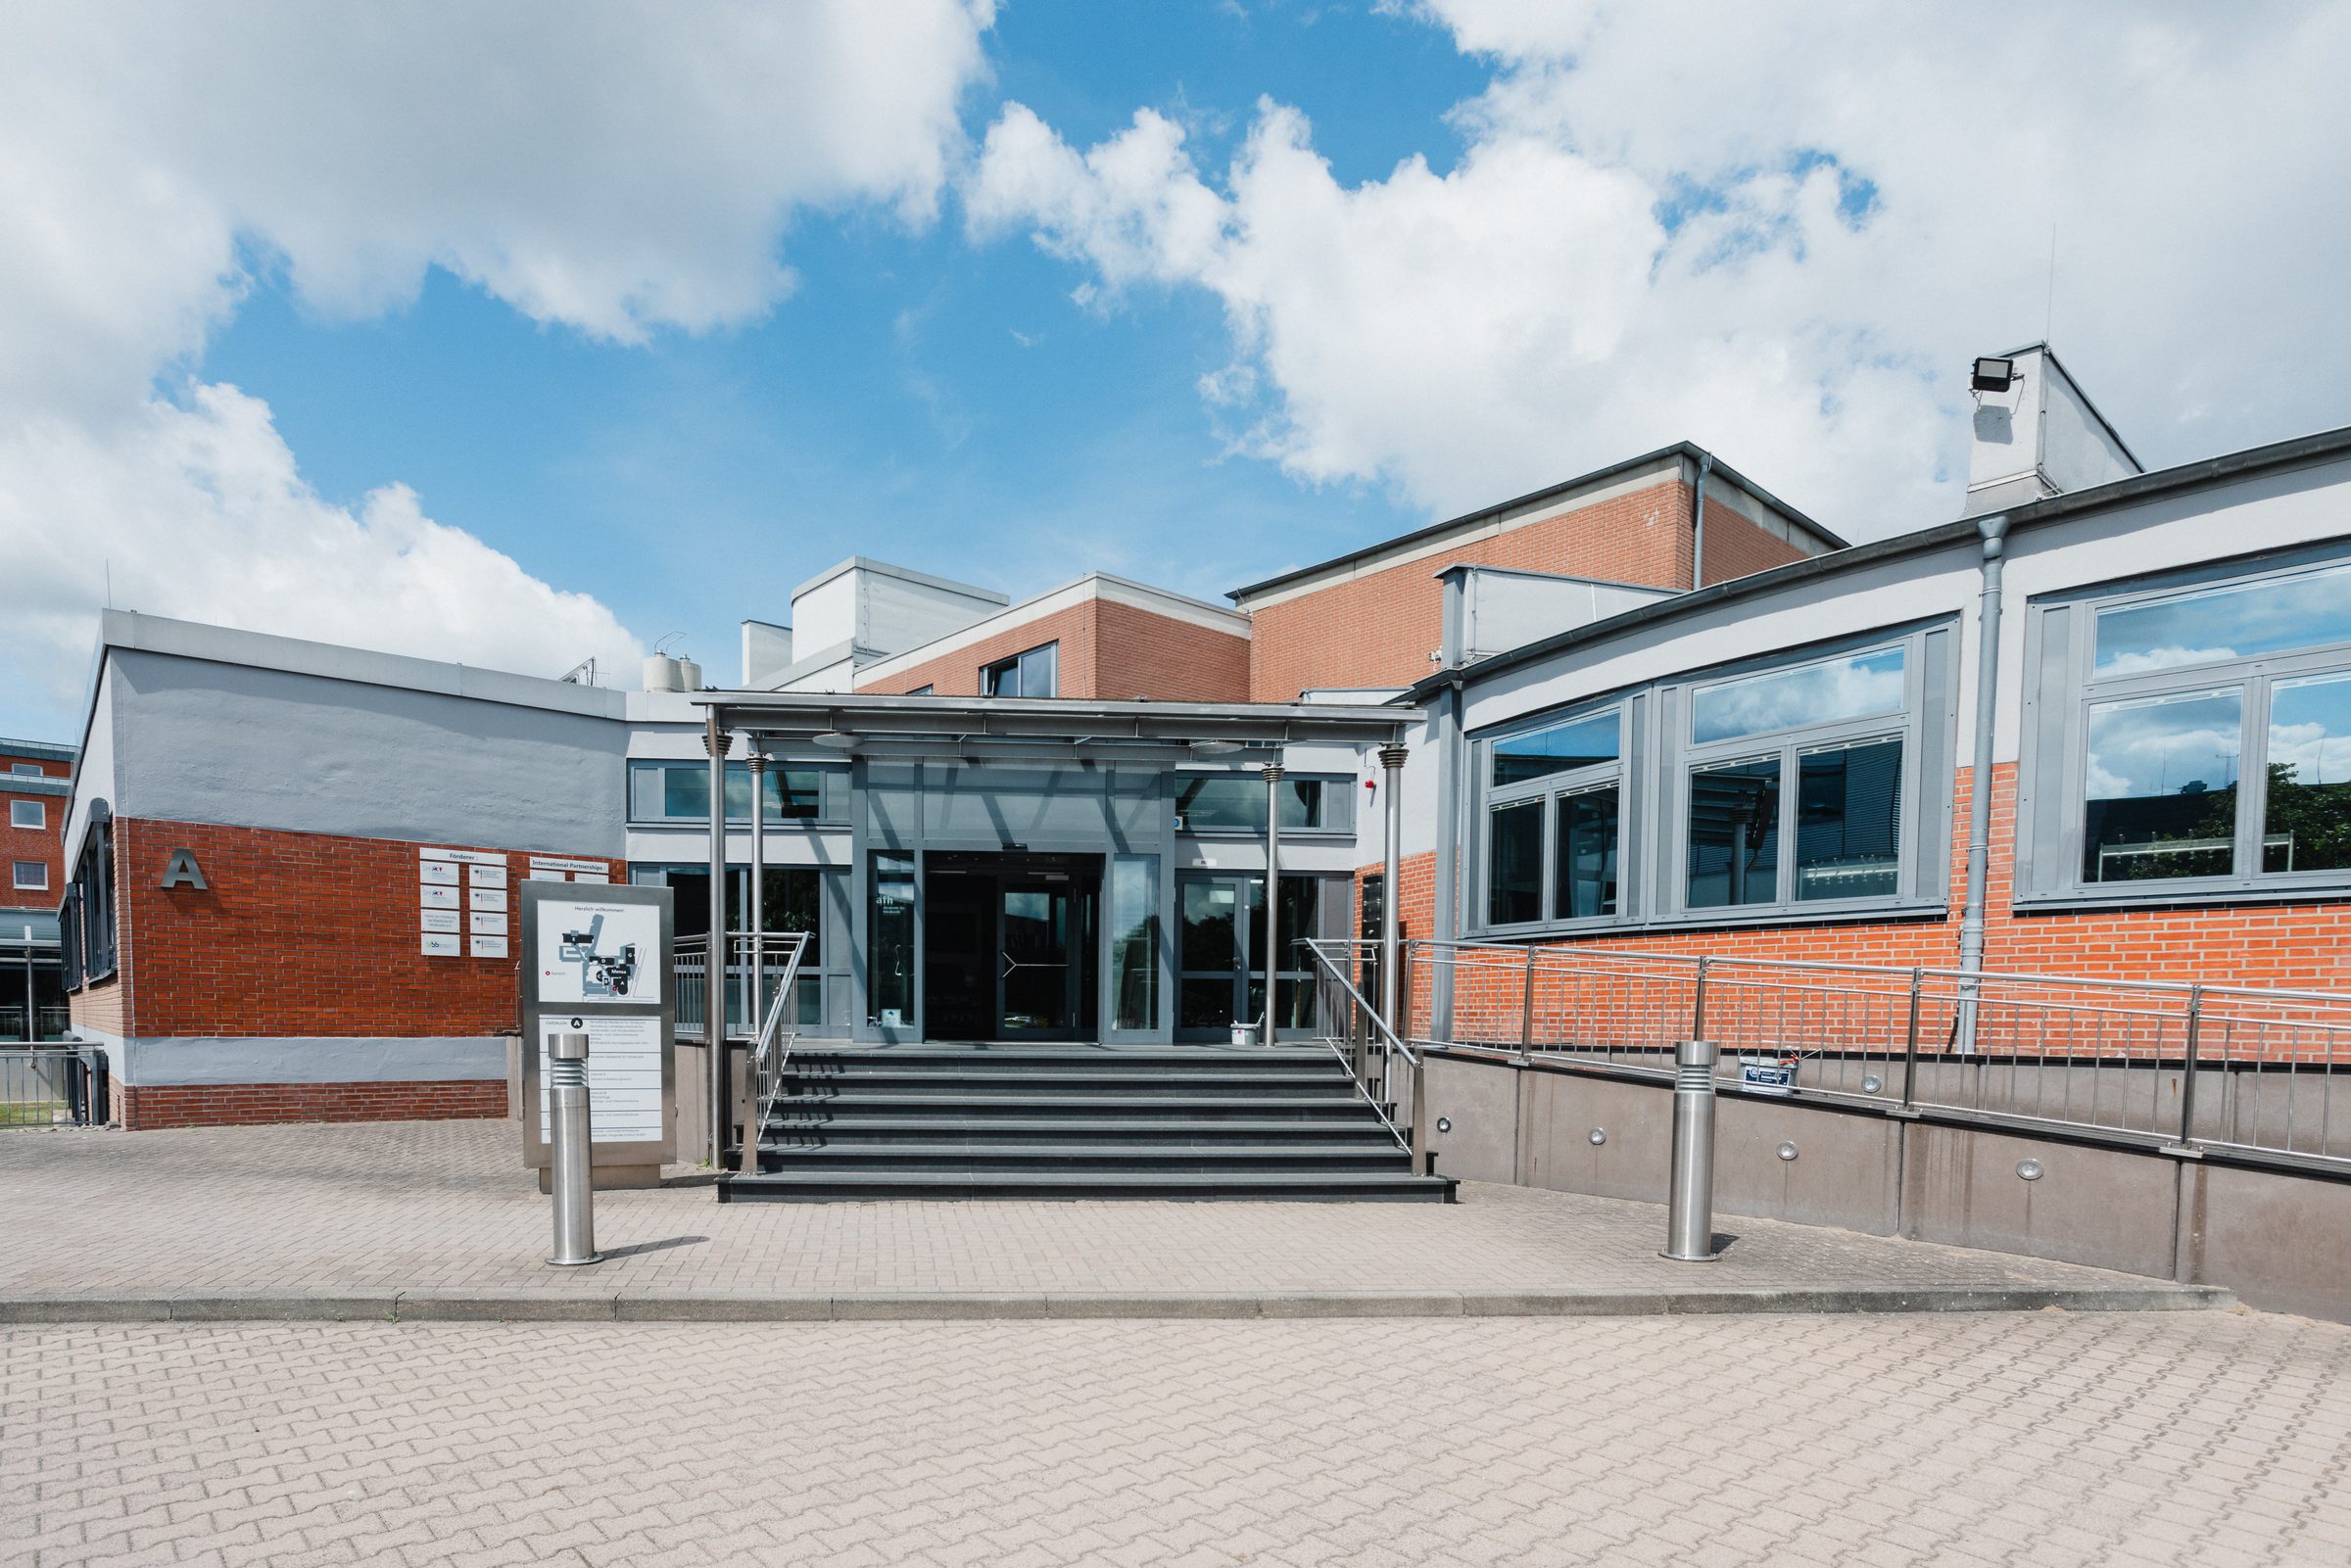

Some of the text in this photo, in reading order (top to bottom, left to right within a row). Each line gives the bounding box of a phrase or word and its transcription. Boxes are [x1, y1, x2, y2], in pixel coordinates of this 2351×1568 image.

[161, 847, 208, 889] A
[532, 860, 603, 872] International Partnerships
